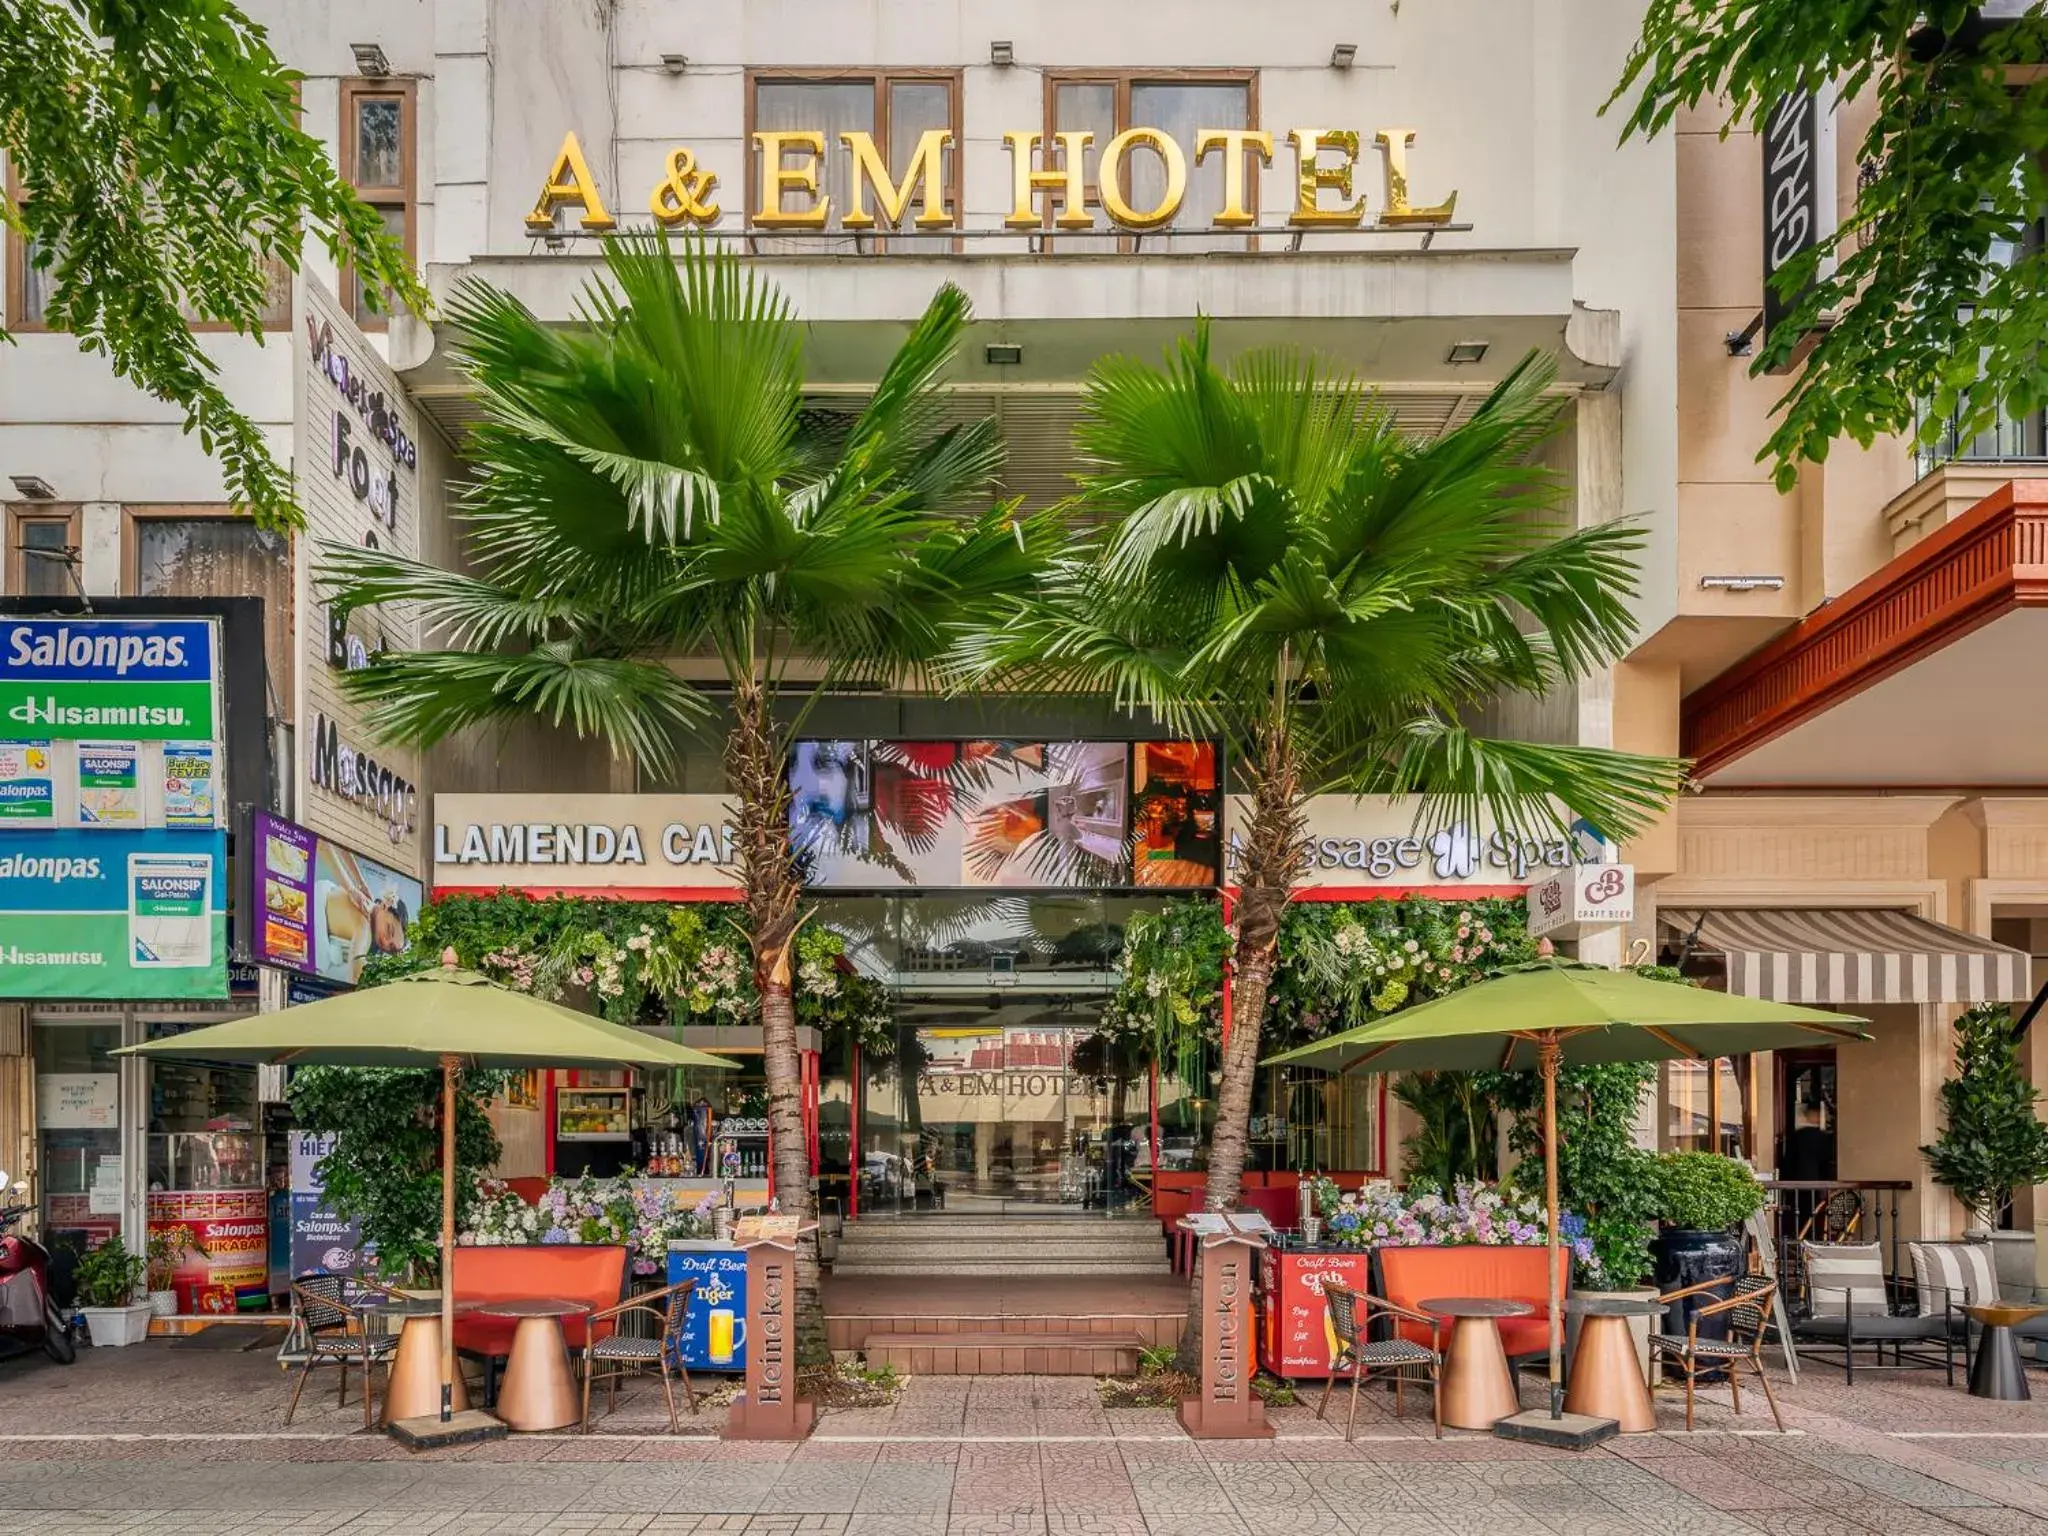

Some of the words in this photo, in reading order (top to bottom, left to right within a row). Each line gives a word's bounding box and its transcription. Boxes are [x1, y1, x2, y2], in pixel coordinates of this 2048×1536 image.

[525, 129, 617, 230] A
[648, 146, 719, 226] &
[751, 129, 954, 230] EM
[1003, 127, 1459, 230] HOTEL
[8, 627, 186, 675] Salonpas
[8, 696, 185, 725] Hisamitsu
[434, 822, 646, 865] LAMENDA
[1490, 830, 1573, 880] Spa
[0, 853, 101, 883] alonpas
[141, 878, 201, 891] SALONSIP
[1577, 910, 1605, 919] CRAFT
[1609, 910, 1632, 919] BEER
[205, 1223, 265, 1238] Salonpas
[296, 1220, 351, 1234] Salonpas
[682, 1257, 716, 1273] Draft
[696, 1287, 735, 1306] Tiger
[758, 1264, 783, 1406] Heineken
[1213, 1262, 1240, 1405] Heineken
